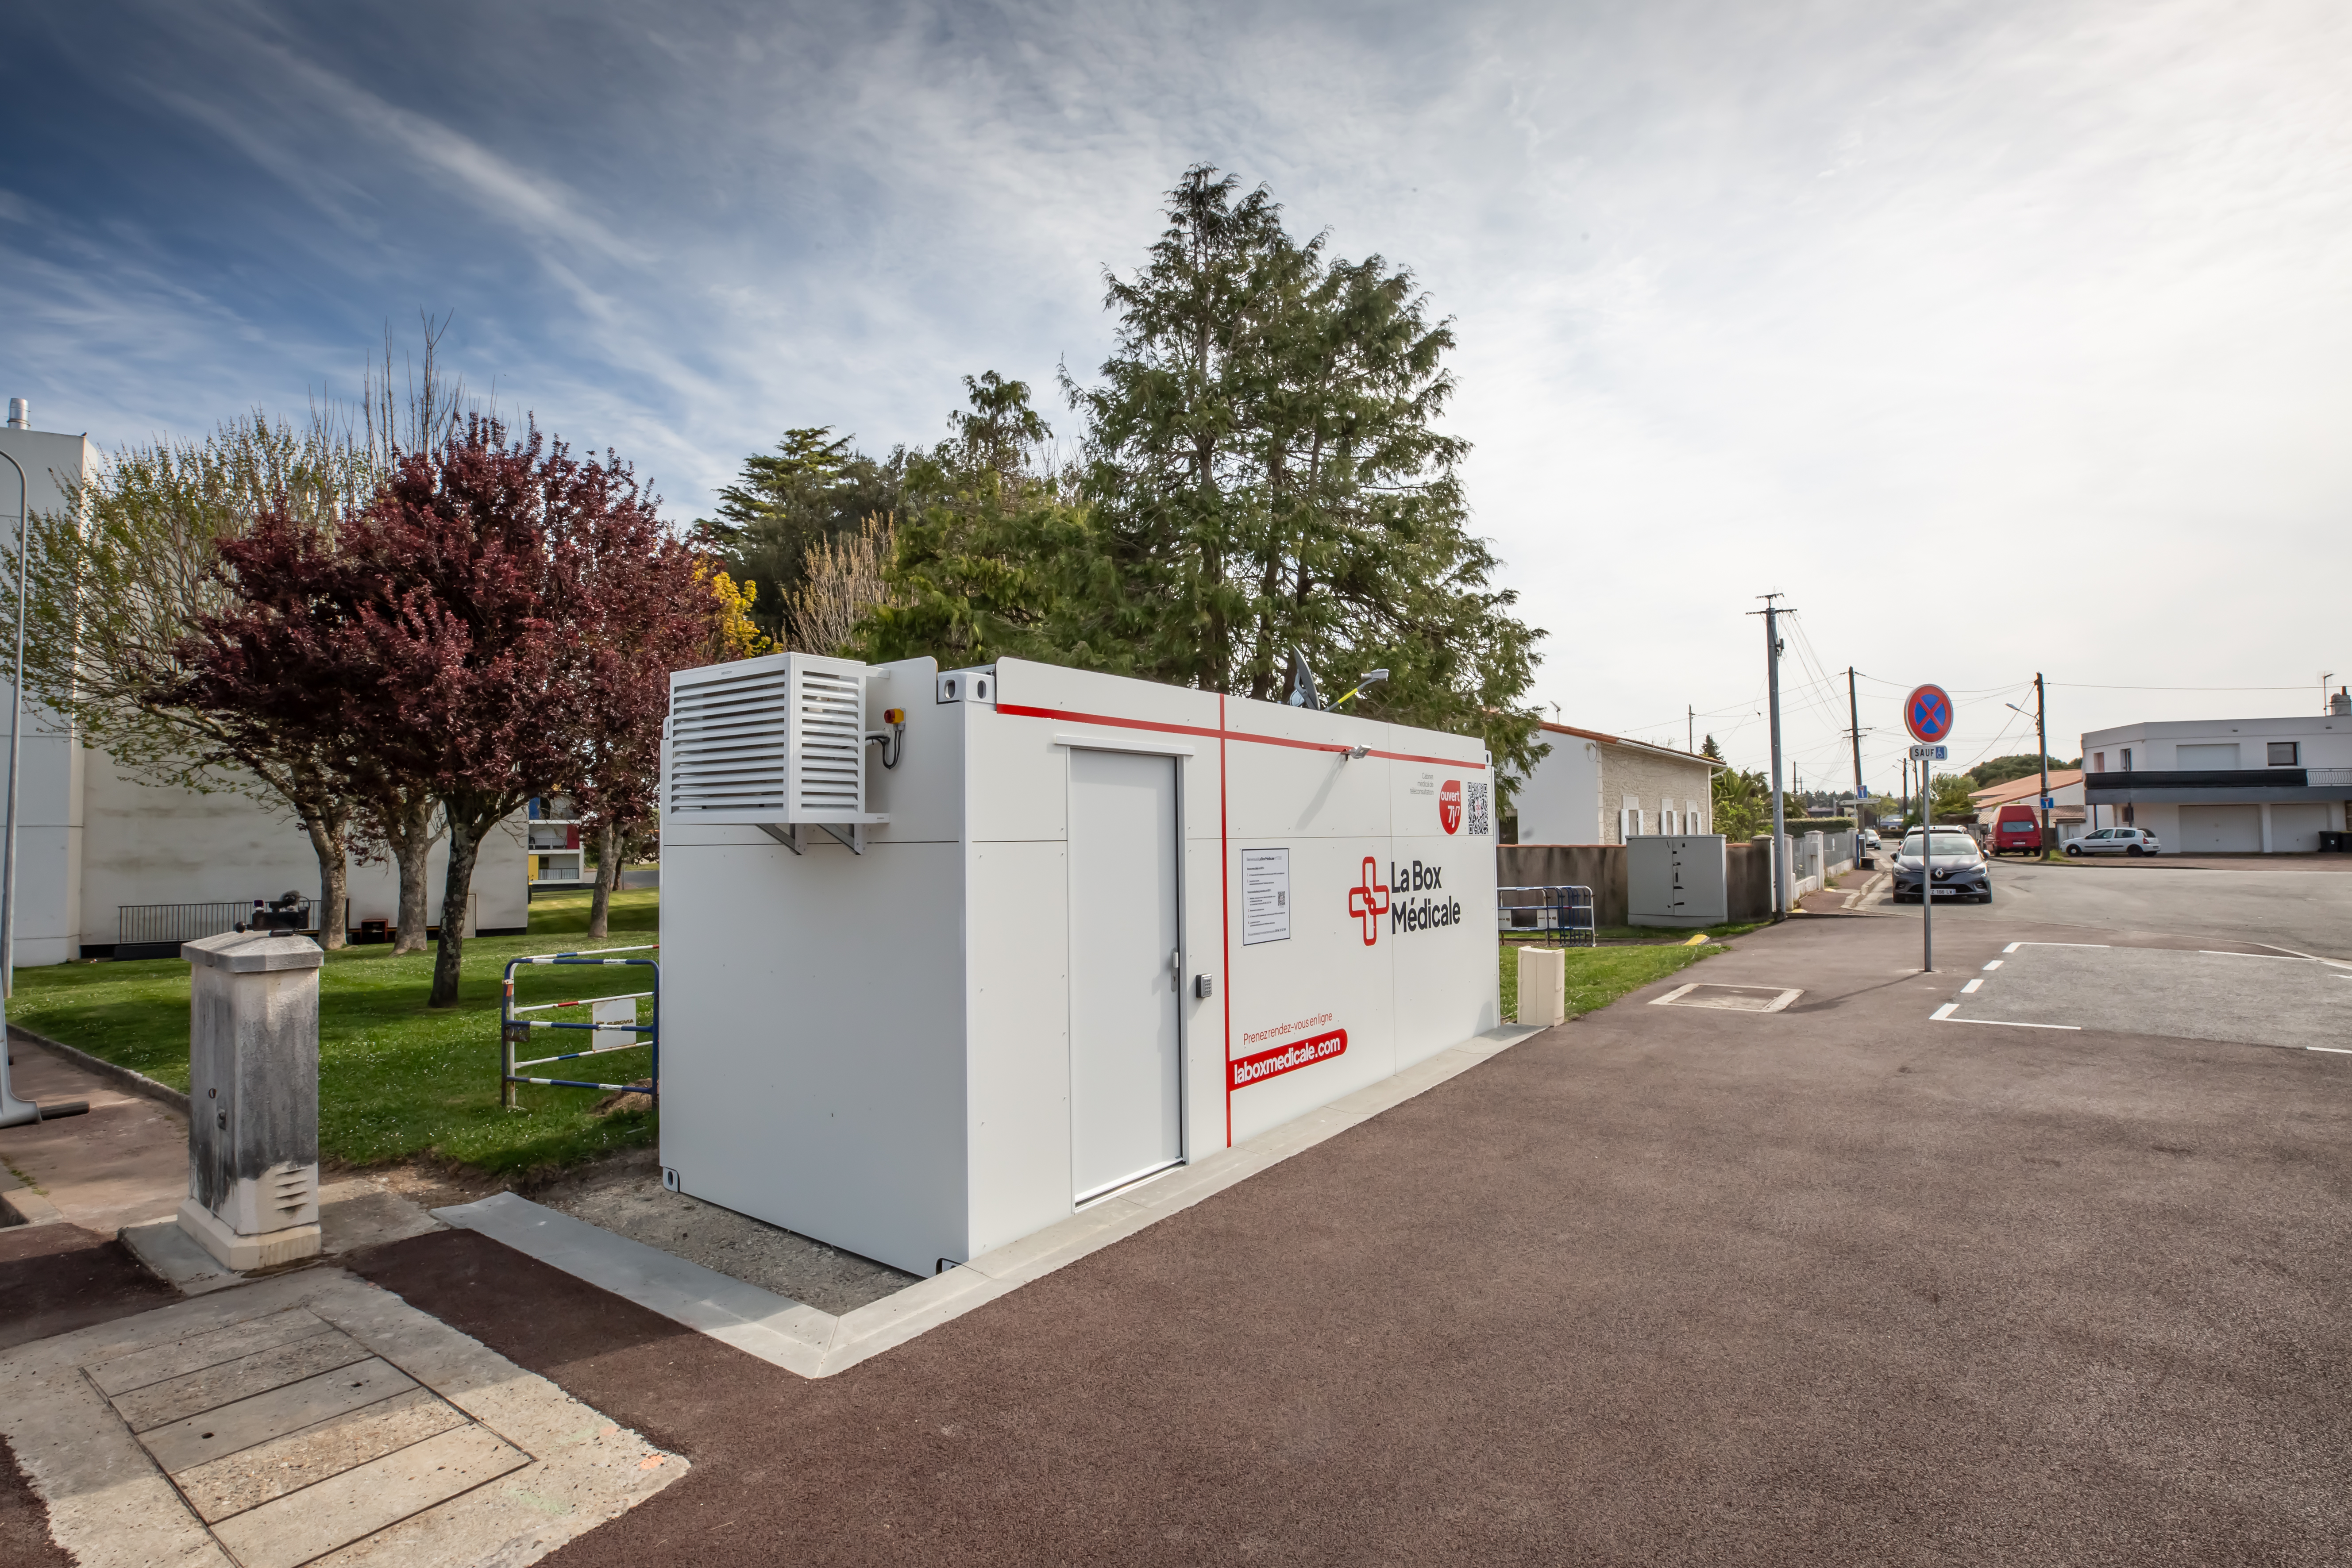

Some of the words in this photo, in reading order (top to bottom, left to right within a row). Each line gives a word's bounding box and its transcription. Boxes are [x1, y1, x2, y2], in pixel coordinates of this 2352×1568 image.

[1441, 791, 1460, 801] ouvert
[1391, 861, 1410, 893] La
[1413, 860, 1442, 891] Box
[1392, 895, 1461, 935] Médicale
[1244, 1030, 1268, 1045] Prenez
[1268, 1019, 1309, 1038] rendez-vous
[1310, 1017, 1318, 1026] en
[1318, 1013, 1332, 1026] ligne
[1234, 1037, 1340, 1085] laboxmedicale.com
